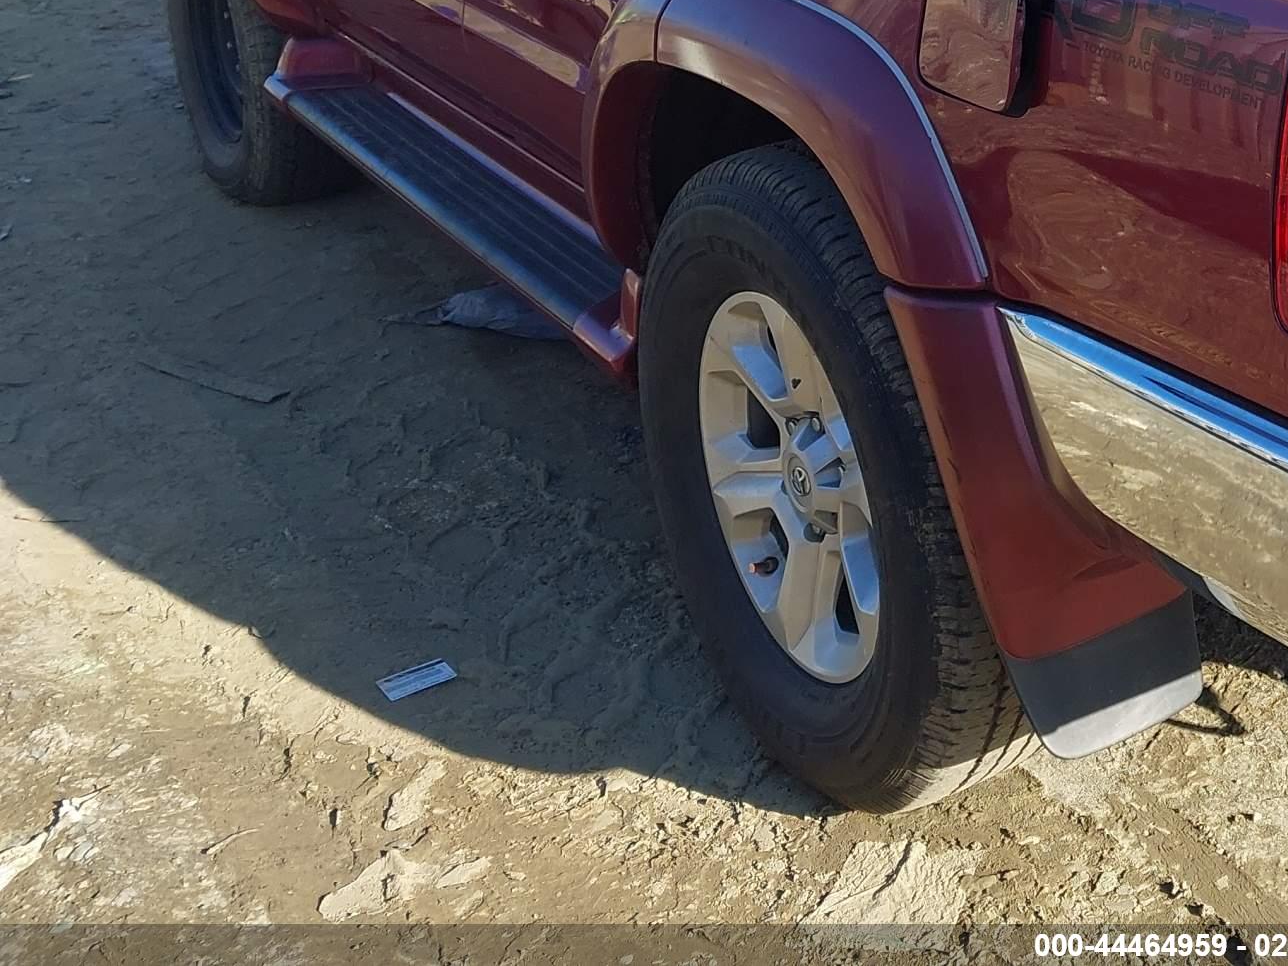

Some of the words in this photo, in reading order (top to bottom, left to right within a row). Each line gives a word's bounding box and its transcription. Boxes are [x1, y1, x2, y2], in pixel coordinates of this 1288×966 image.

[1081, 40, 1125, 64] TOYOTA
[1127, 55, 1172, 80] RACING
[1174, 71, 1266, 110] DEVELOPMENT
[1140, 27, 1283, 96] ROAD
